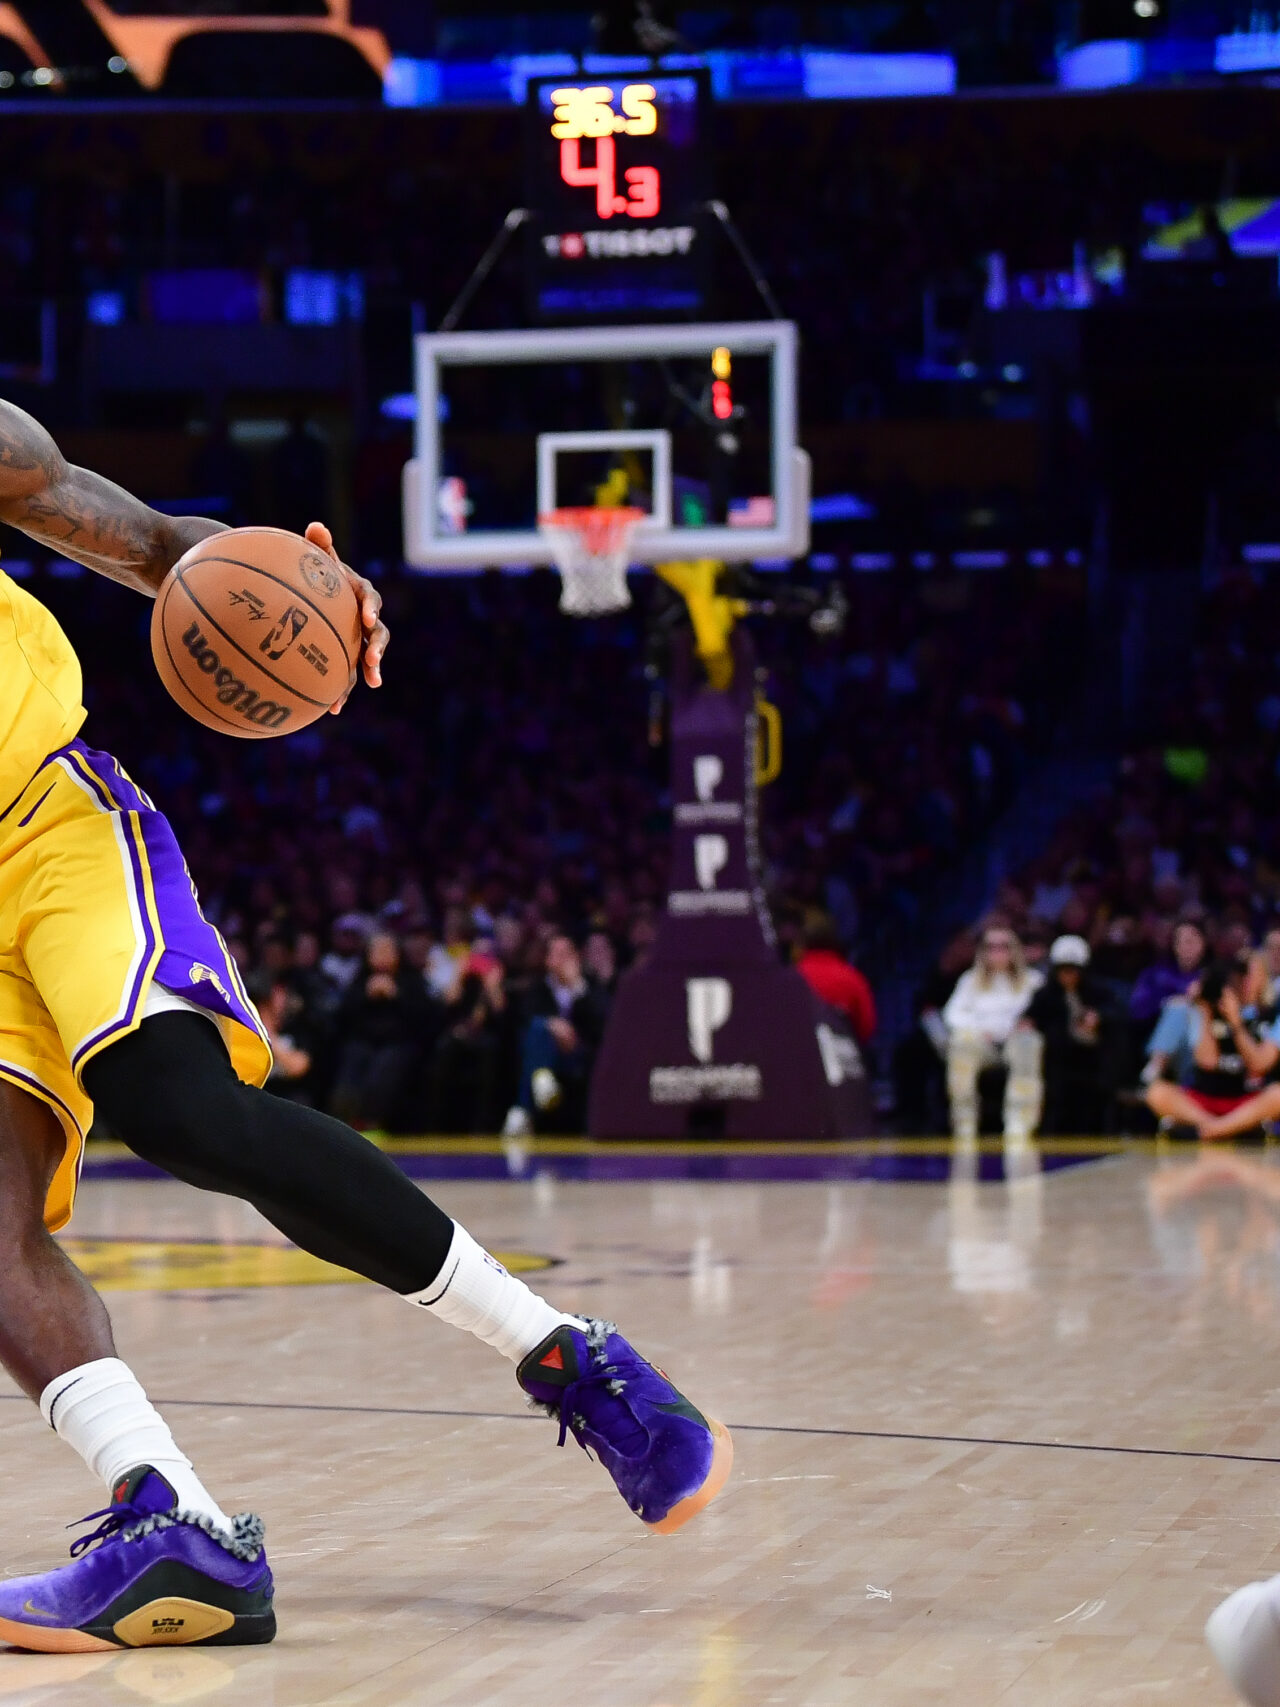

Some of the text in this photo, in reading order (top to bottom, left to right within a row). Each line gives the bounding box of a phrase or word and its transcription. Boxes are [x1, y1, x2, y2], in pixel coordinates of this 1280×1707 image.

[550, 84, 657, 139] 36.5
[560, 137, 660, 219] 4.3
[584, 226, 695, 258] TISSOT
